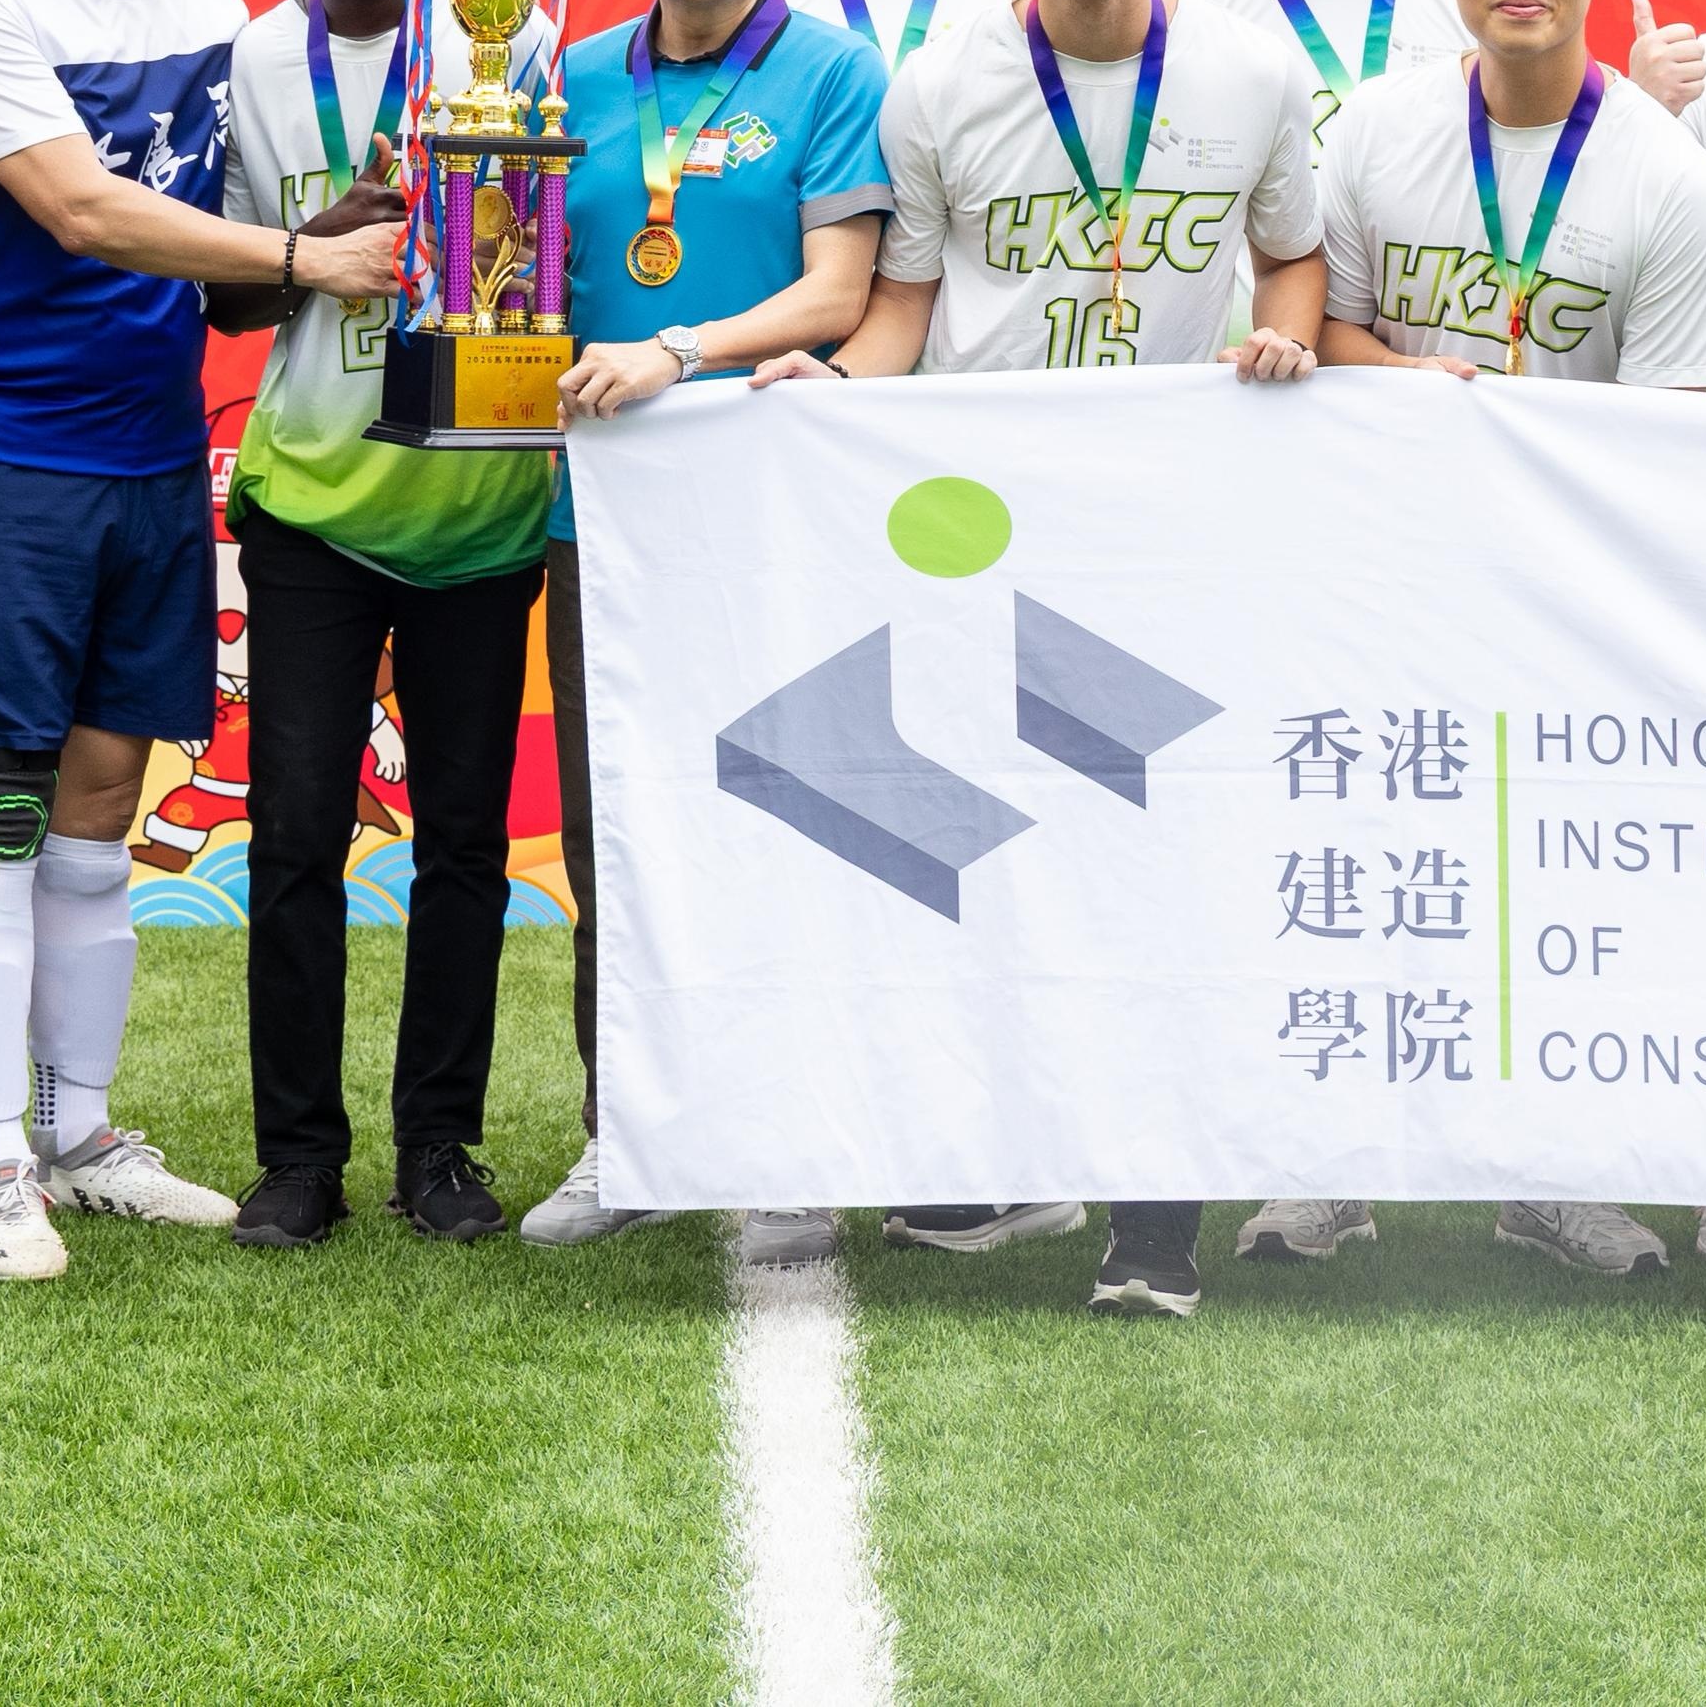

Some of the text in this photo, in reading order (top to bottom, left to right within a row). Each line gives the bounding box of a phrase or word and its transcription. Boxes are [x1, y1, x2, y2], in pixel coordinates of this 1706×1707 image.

[1044, 297, 1141, 369] 16
[1272, 708, 1470, 802] 香港
[1275, 846, 1471, 941] 建造
[1538, 924, 1623, 977] OF
[1278, 987, 1474, 1084] 學院
